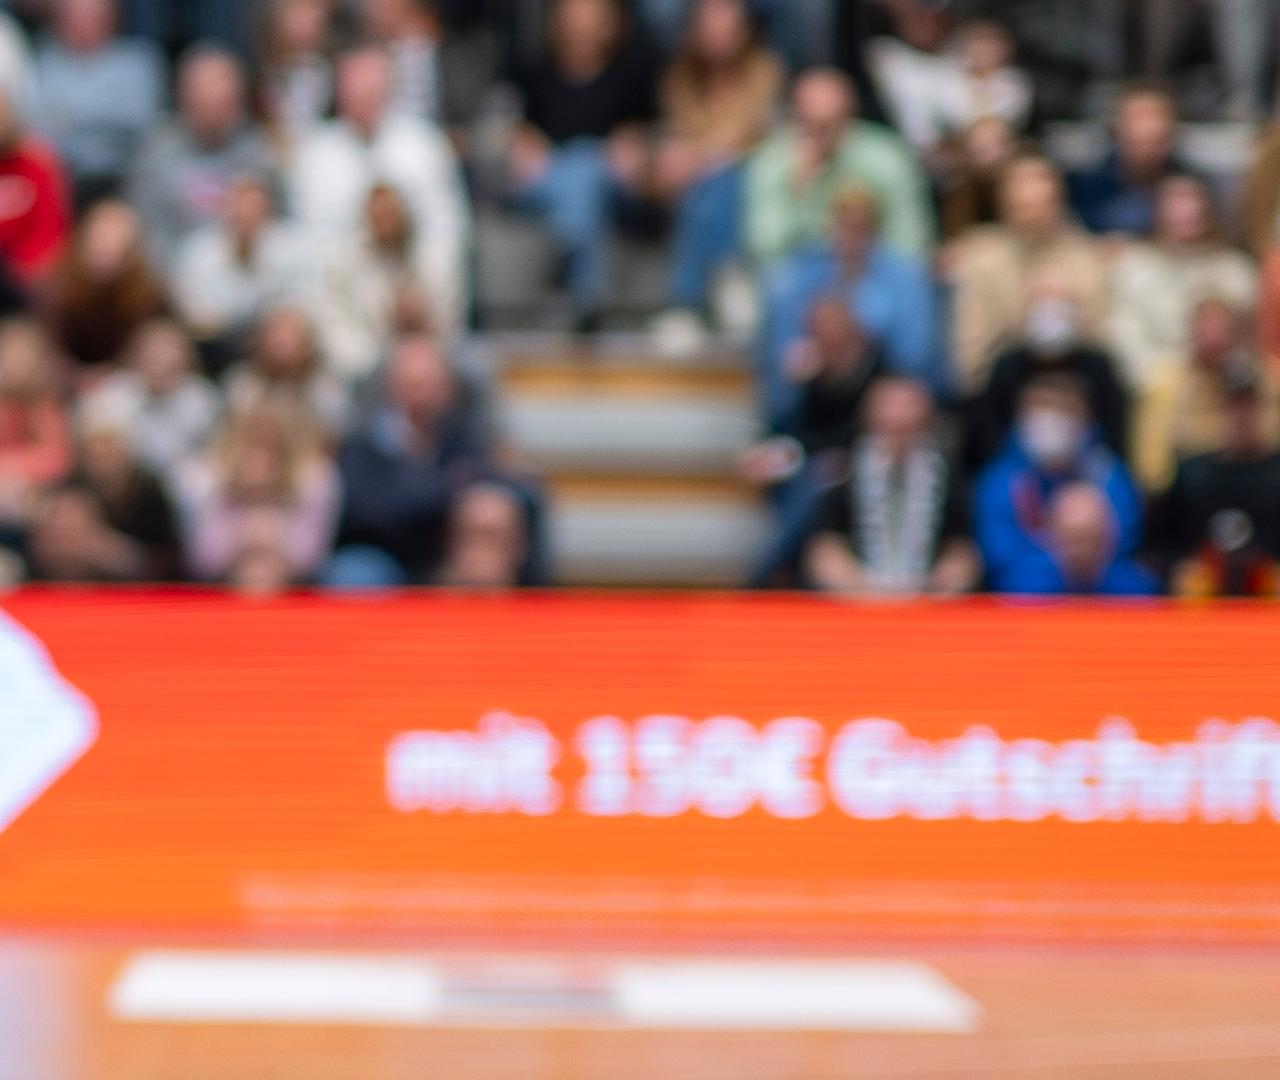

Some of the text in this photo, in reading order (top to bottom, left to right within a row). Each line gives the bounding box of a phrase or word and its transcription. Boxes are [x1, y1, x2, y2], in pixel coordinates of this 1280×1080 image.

[386, 711, 1280, 823] mit 150€ Gutschrif
